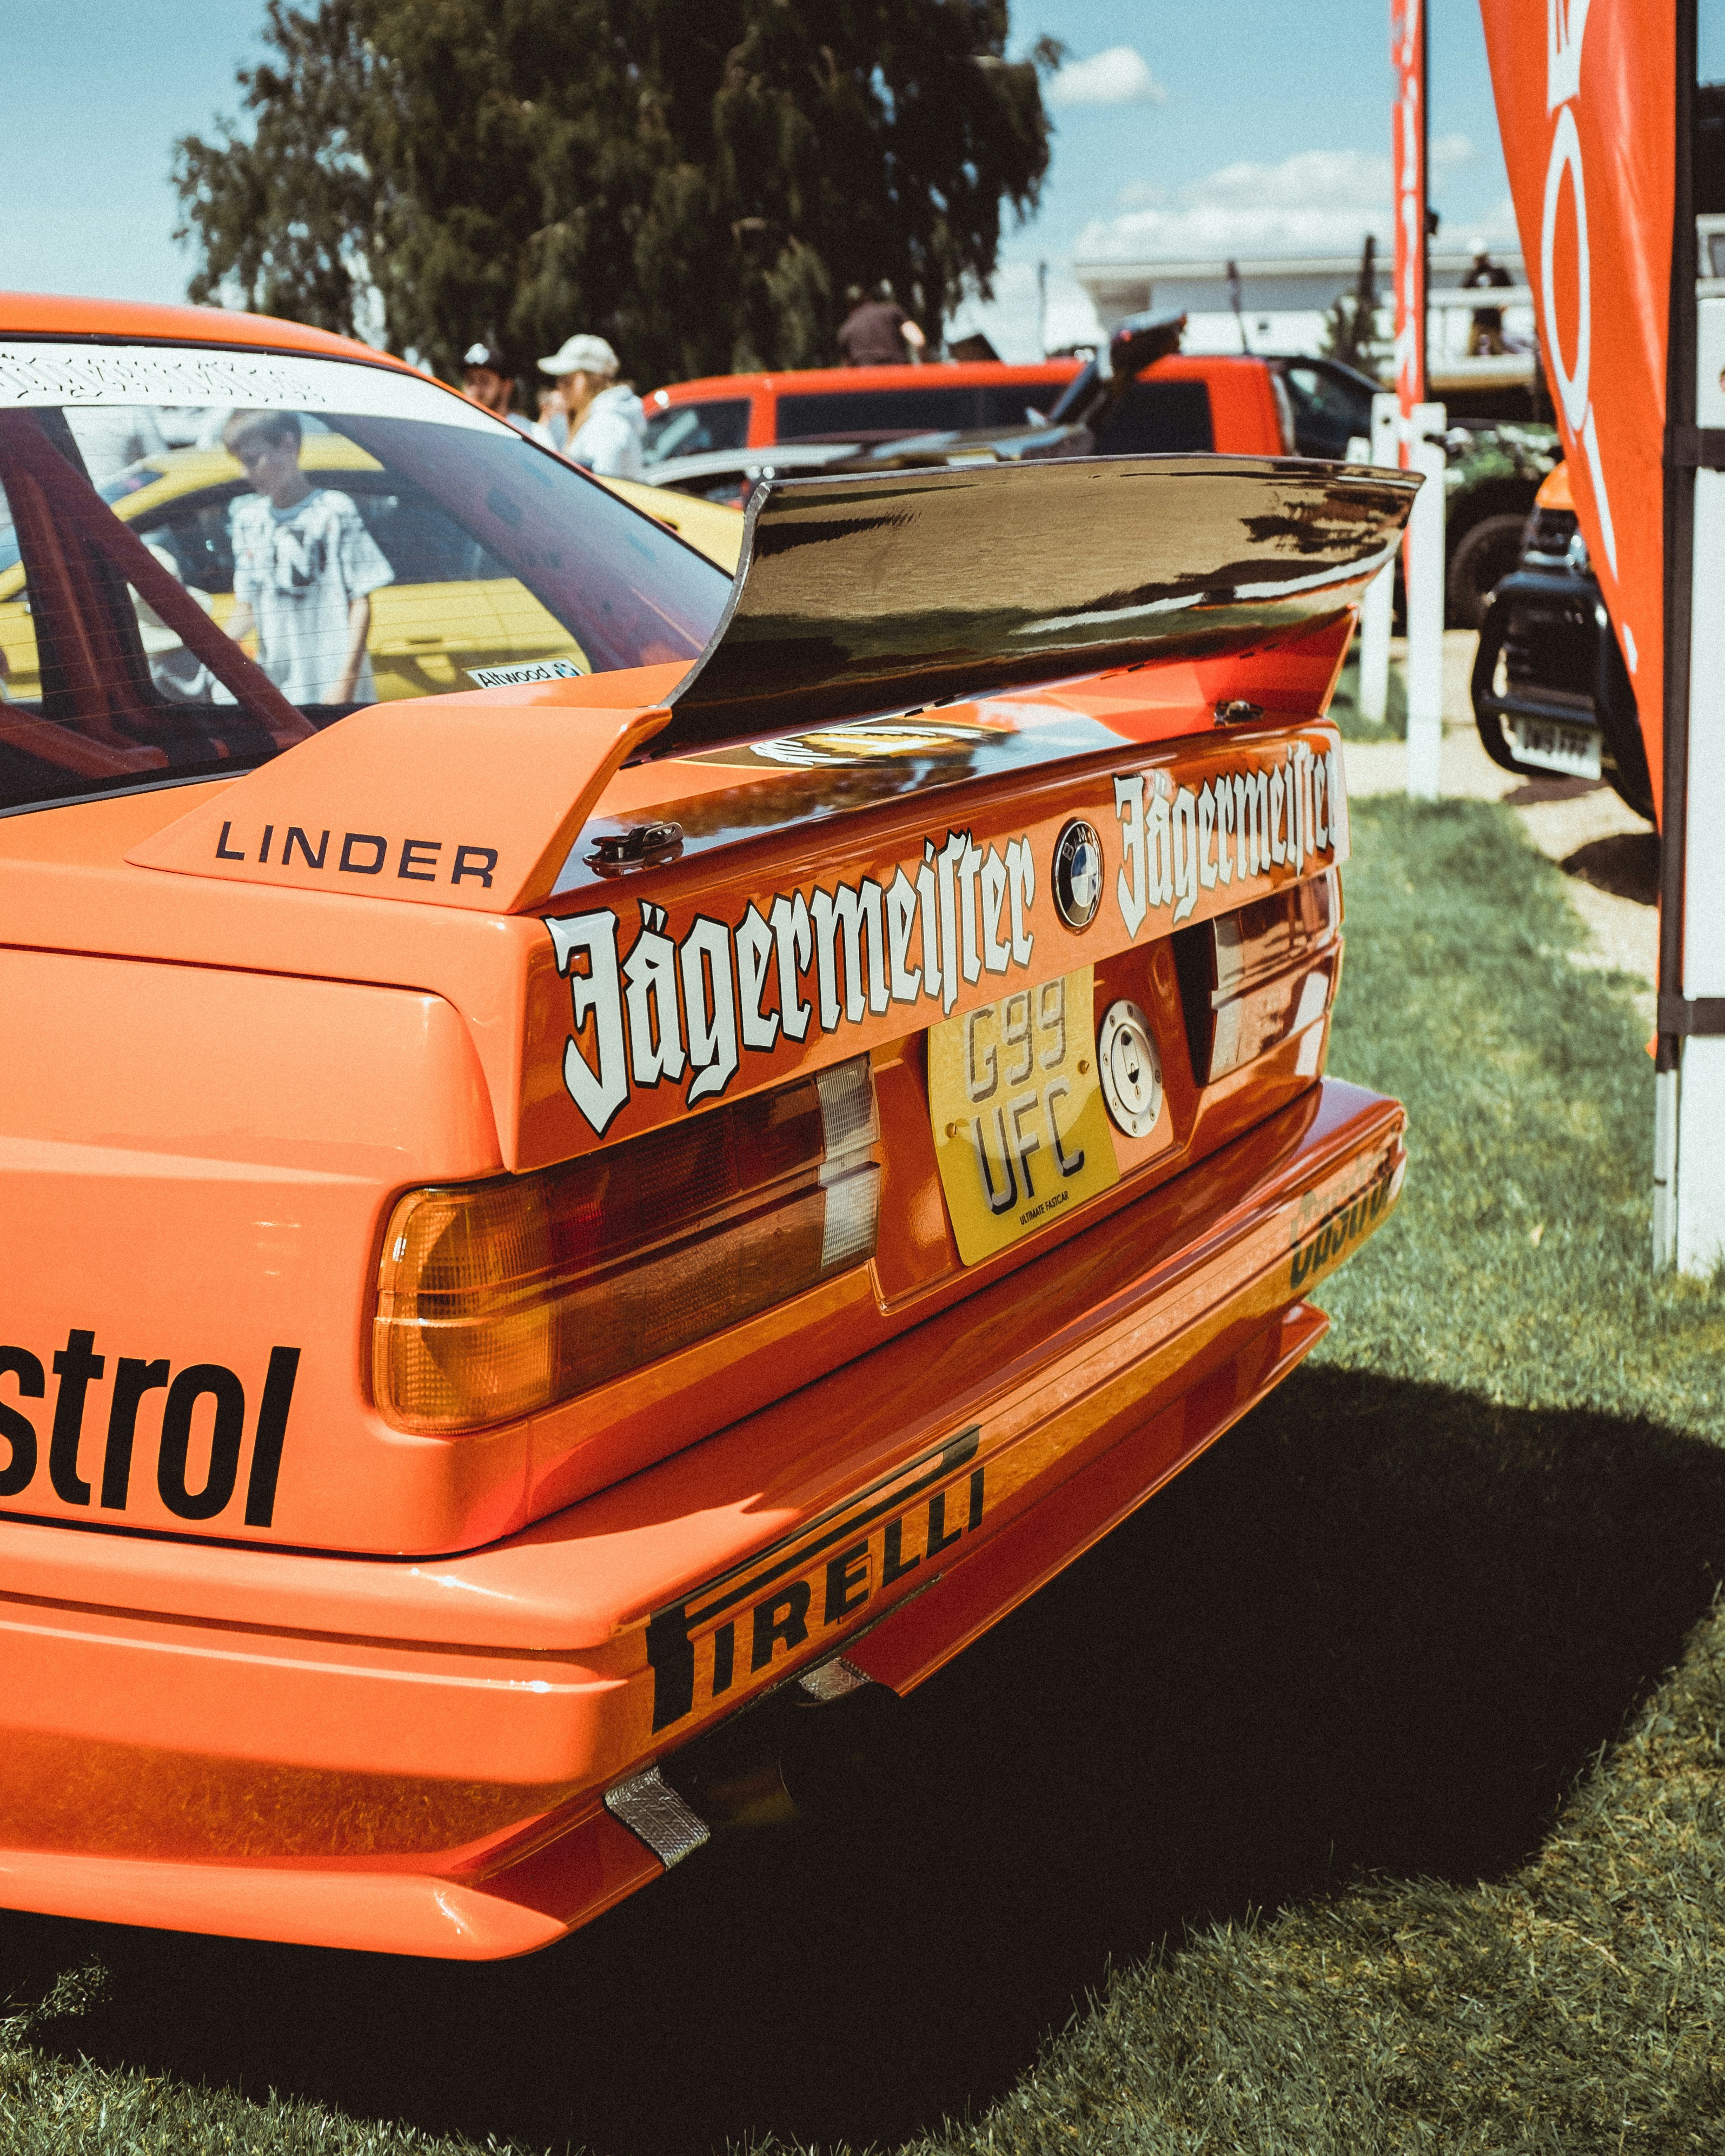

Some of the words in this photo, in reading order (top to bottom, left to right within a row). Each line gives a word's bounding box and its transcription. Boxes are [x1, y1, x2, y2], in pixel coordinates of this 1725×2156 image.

[215, 820, 499, 889] LINDER
[540, 827, 1036, 1139] Jägermeister
[964, 977, 1067, 1103] G99
[970, 1074, 1085, 1216] UFC
[1018, 1204, 1045, 1226] ULTIMATE
[1045, 1190, 1069, 1211] FASTCAR
[645, 1423, 985, 1736] PIRELLI
